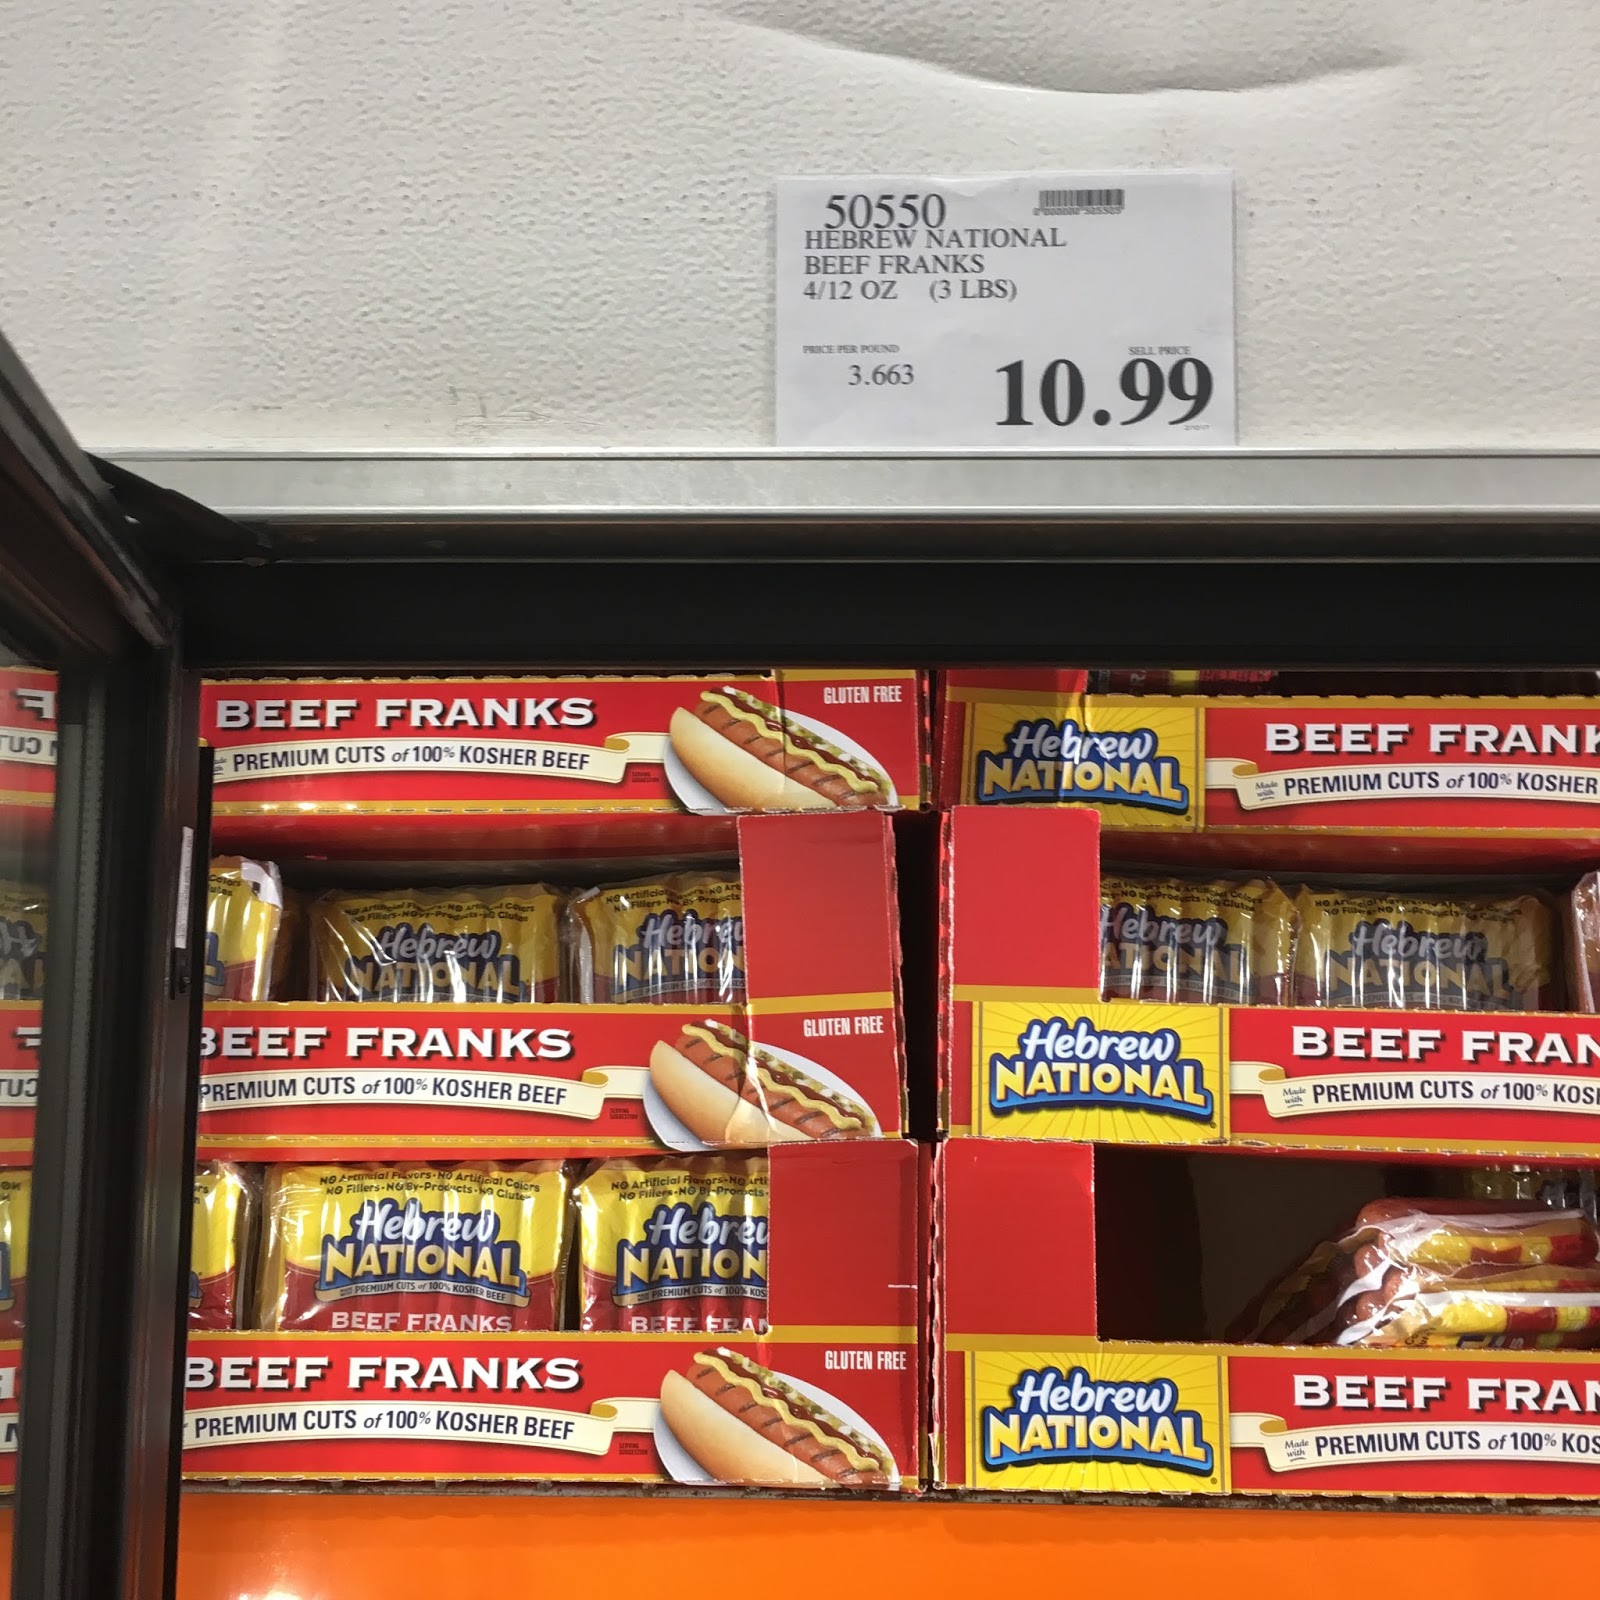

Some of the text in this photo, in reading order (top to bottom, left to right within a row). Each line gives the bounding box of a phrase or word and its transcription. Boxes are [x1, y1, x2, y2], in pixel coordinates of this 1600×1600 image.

[824, 193, 946, 230] 50550
[805, 228, 1067, 250] HEBREW NATIONAL
[805, 254, 985, 275] BEEF FRANKS
[803, 279, 1018, 302] 4/12 OZ (3 LBS)
[803, 344, 900, 354] PRICE PER POUND
[1128, 346, 1191, 355] SELL PRICE
[848, 364, 914, 385] 3.663
[995, 357, 1213, 426] 10.99
[824, 685, 902, 704] GLUTEN FREE
[216, 697, 596, 730] BEEF FRANKS
[1011, 723, 1153, 762] Hebrew
[1265, 722, 1410, 753] BEEF
[233, 748, 329, 772] PREMIUM
[335, 746, 385, 764] CUTS
[392, 750, 409, 763] of
[413, 745, 455, 764] 100%
[460, 745, 537, 767] KOSHER
[542, 750, 590, 770] BEEF
[983, 756, 1183, 802] NATIONAL
[1284, 771, 1599, 797] PREMIUM CUTS of 100% KOSHER
[1100, 906, 1222, 943] Hebrew
[380, 926, 497, 959] Hebrew
[1353, 921, 1483, 960] Hebrew
[803, 1016, 884, 1037] GLUTEN FREE
[346, 1026, 573, 1058] FRANKS
[1023, 1022, 1175, 1061] Hebrew
[1292, 1026, 1441, 1060] BEEF
[200, 1077, 567, 1105] PREMIUM CUTS of 100% KOSHER BEEF
[996, 1060, 1206, 1106] NATIONAL
[1282, 1086, 1306, 1096] Made
[1313, 1080, 1600, 1106] PREMIUM CUTS of 100% KOS
[355, 1203, 494, 1242] Hebrew
[326, 1242, 520, 1287] NATIONAL
[355, 1281, 394, 1294] PREMIUM
[396, 1281, 415, 1291] CUTS
[429, 1281, 450, 1291] 100%
[453, 1283, 484, 1297] KOSHER
[486, 1290, 506, 1301] BEEF
[652, 1286, 690, 1299] PREMIUM
[692, 1285, 712, 1294] CUTS
[725, 1286, 748, 1295] 100%
[332, 1311, 512, 1332] BEEF FRANKS
[185, 1356, 581, 1390] BEEF FRANKS
[825, 1350, 906, 1370] GLUTEN FREE
[1017, 1372, 1173, 1413] Hebrew
[1293, 1374, 1446, 1411] BEEF
[195, 1410, 575, 1440] PREMIUM CUTS of 100% KOSHER BEEF
[989, 1413, 1207, 1462] NATIONAL
[1285, 1439, 1309, 1449] Made
[1286, 1449, 1306, 1457] with
[1315, 1431, 1419, 1456] PREMIUM
[1426, 1430, 1480, 1450] CUTS
[1488, 1435, 1507, 1450] of
[1510, 1432, 1557, 1451] 100%
